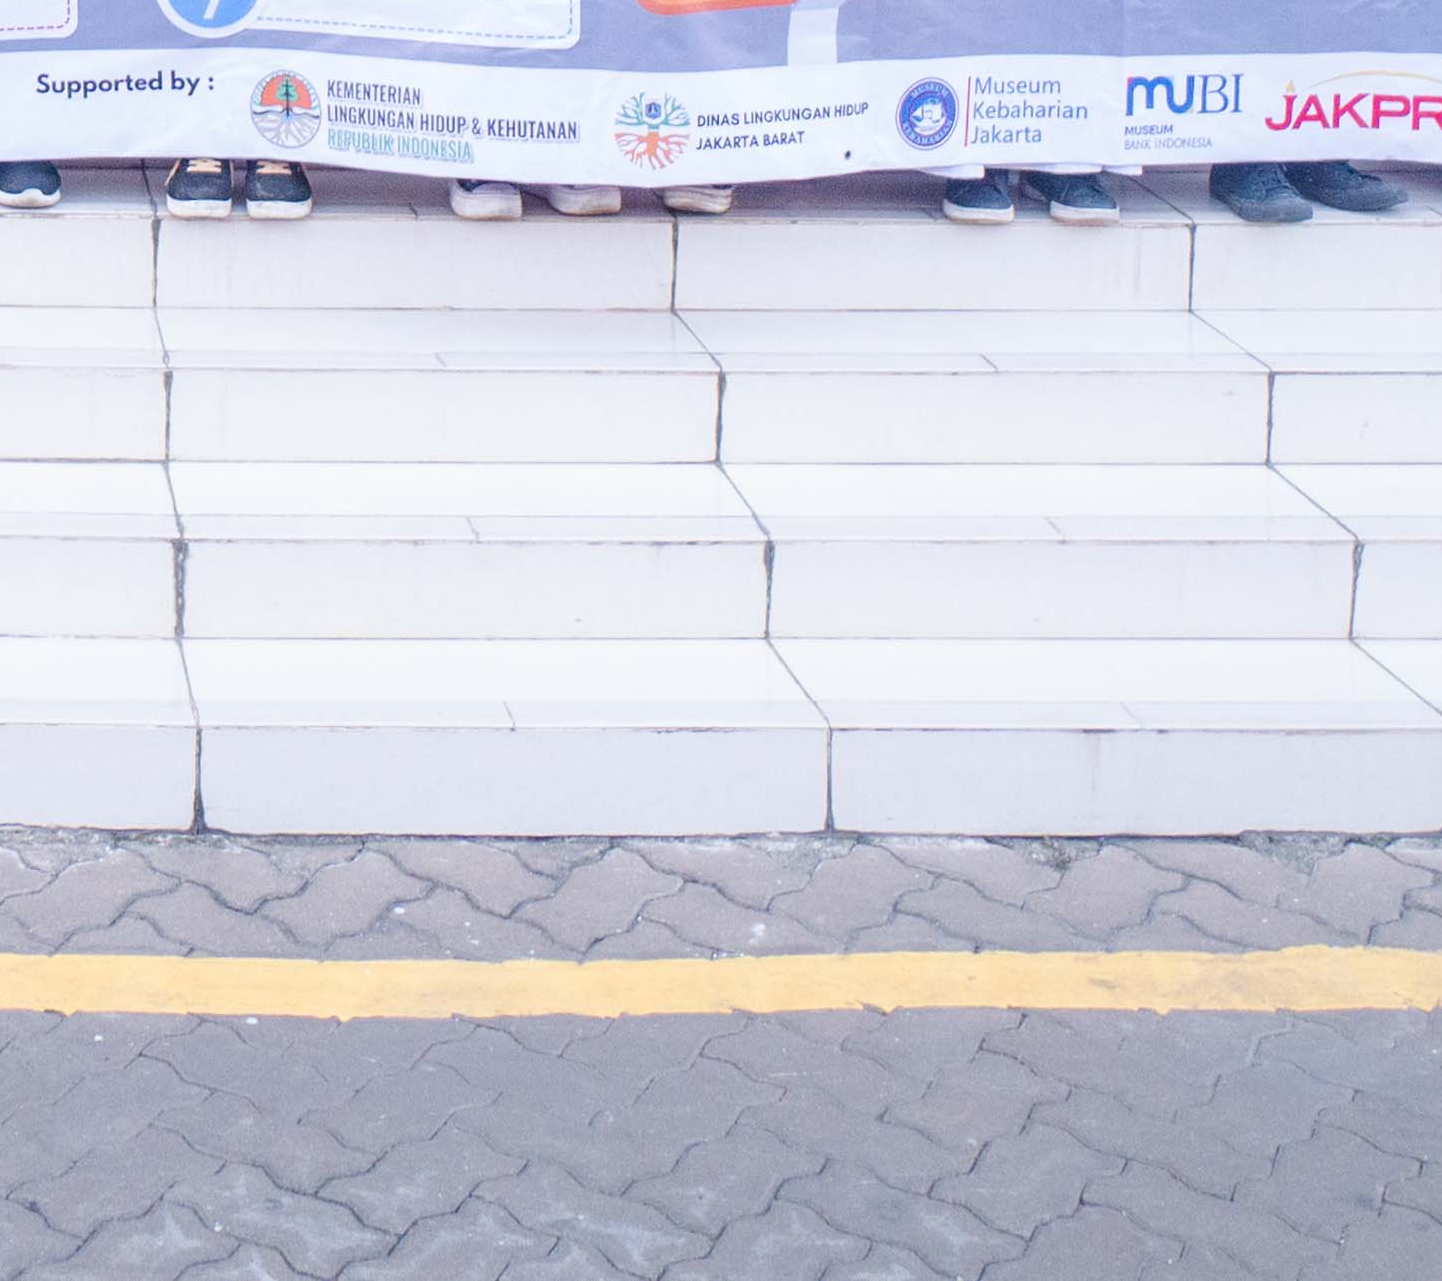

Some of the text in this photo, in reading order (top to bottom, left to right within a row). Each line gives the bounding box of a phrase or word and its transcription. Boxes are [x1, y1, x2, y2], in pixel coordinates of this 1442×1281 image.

[36, 70, 164, 98] Supported
[171, 71, 202, 95] by
[327, 79, 421, 105] KEMENTERIAN
[974, 76, 1061, 95] Museum
[697, 102, 868, 127] DINAS LINGKUNGAN HIDUP
[972, 100, 1088, 120] Kebaharian
[327, 105, 577, 139] LINGKUNGAN HIDUP & KEHUTANAN
[1125, 125, 1173, 135] MUSEUM
[327, 128, 472, 160] REPUBLIK INDONESIA
[696, 131, 804, 150] JAKARTA BARAT
[970, 124, 1042, 145] Jakarta
[1125, 137, 1212, 150] BANK INDONESIA
